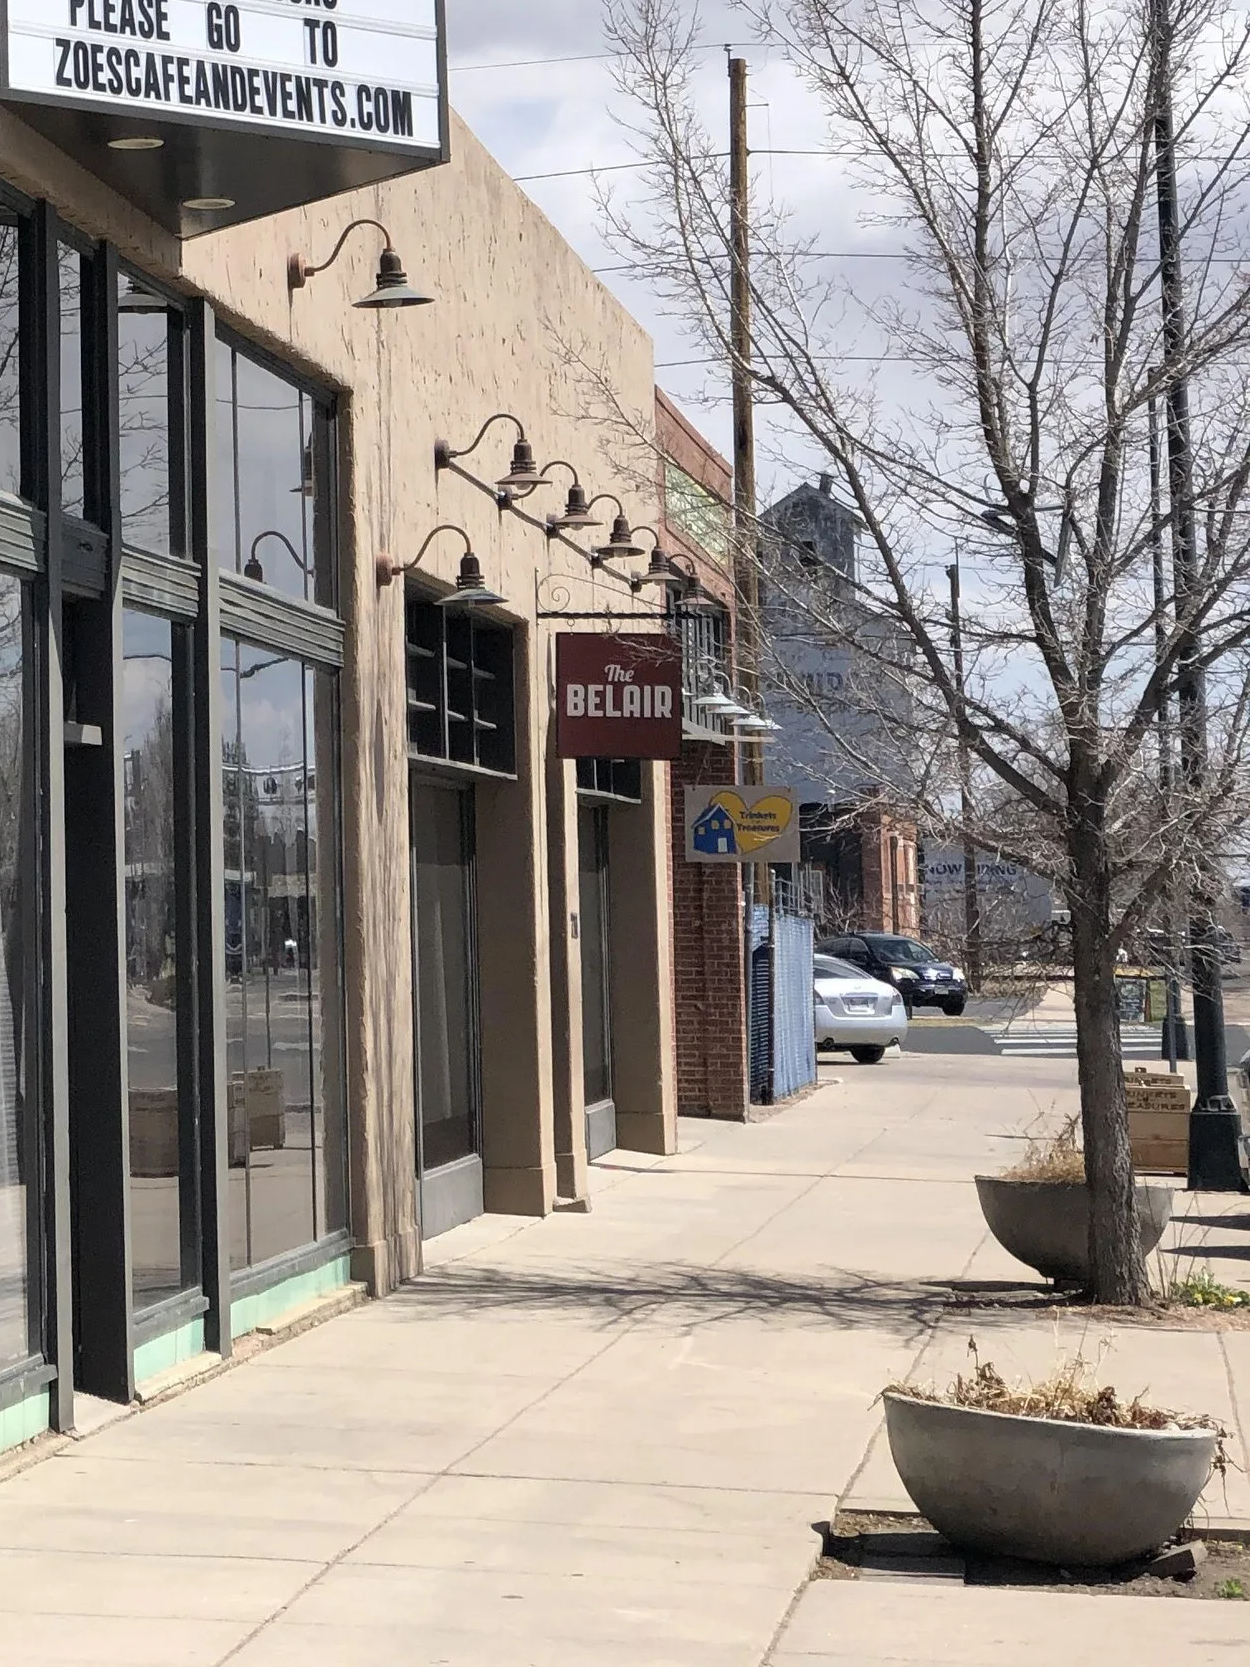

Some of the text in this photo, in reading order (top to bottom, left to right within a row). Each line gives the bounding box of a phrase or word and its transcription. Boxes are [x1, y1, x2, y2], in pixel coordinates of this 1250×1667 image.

[206, 2, 241, 53] GO
[303, 17, 339, 68] TO
[54, 37, 415, 138] ZOESCAFEANDEVENTS.COM
[604, 664, 635, 683] The
[566, 683, 673, 719] BELAIR
